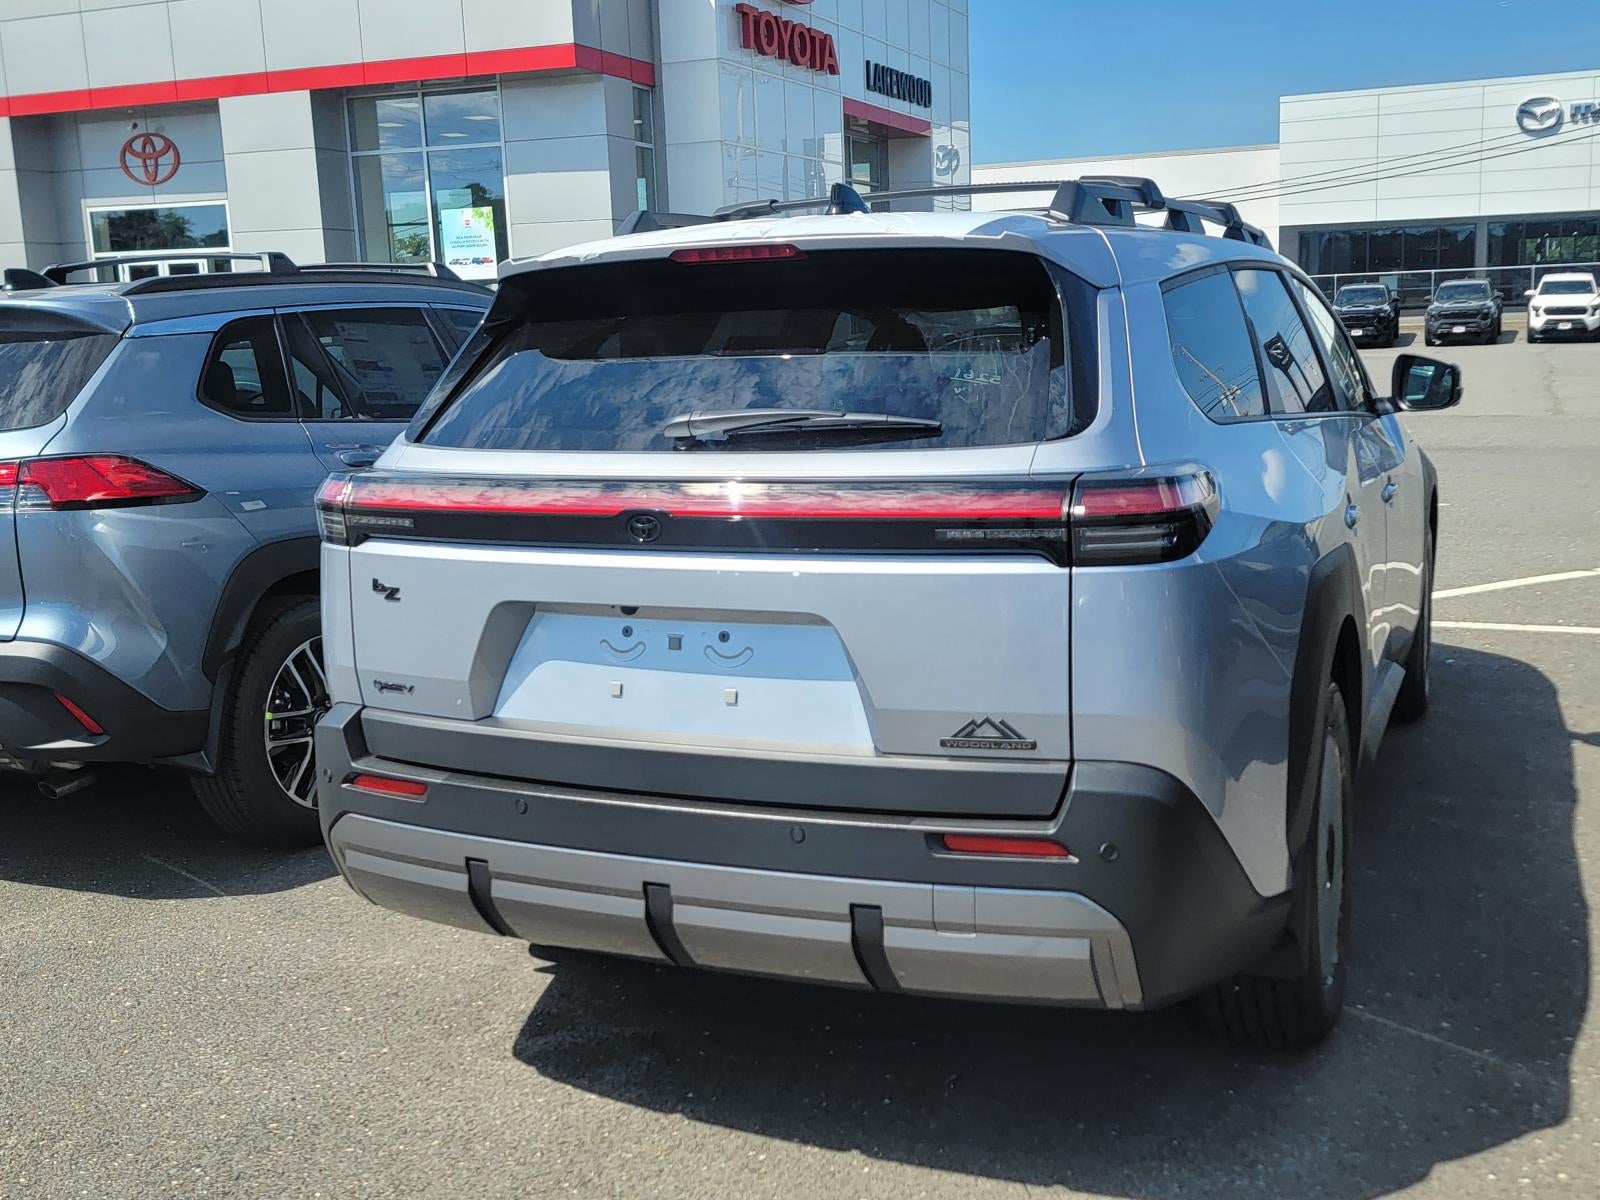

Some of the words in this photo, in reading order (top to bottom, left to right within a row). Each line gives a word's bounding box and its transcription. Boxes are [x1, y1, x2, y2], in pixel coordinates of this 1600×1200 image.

[735, 3, 840, 76] TOYOTA
[865, 59, 932, 108] LAKEWOOD
[944, 739, 1032, 750] WOODLAND
